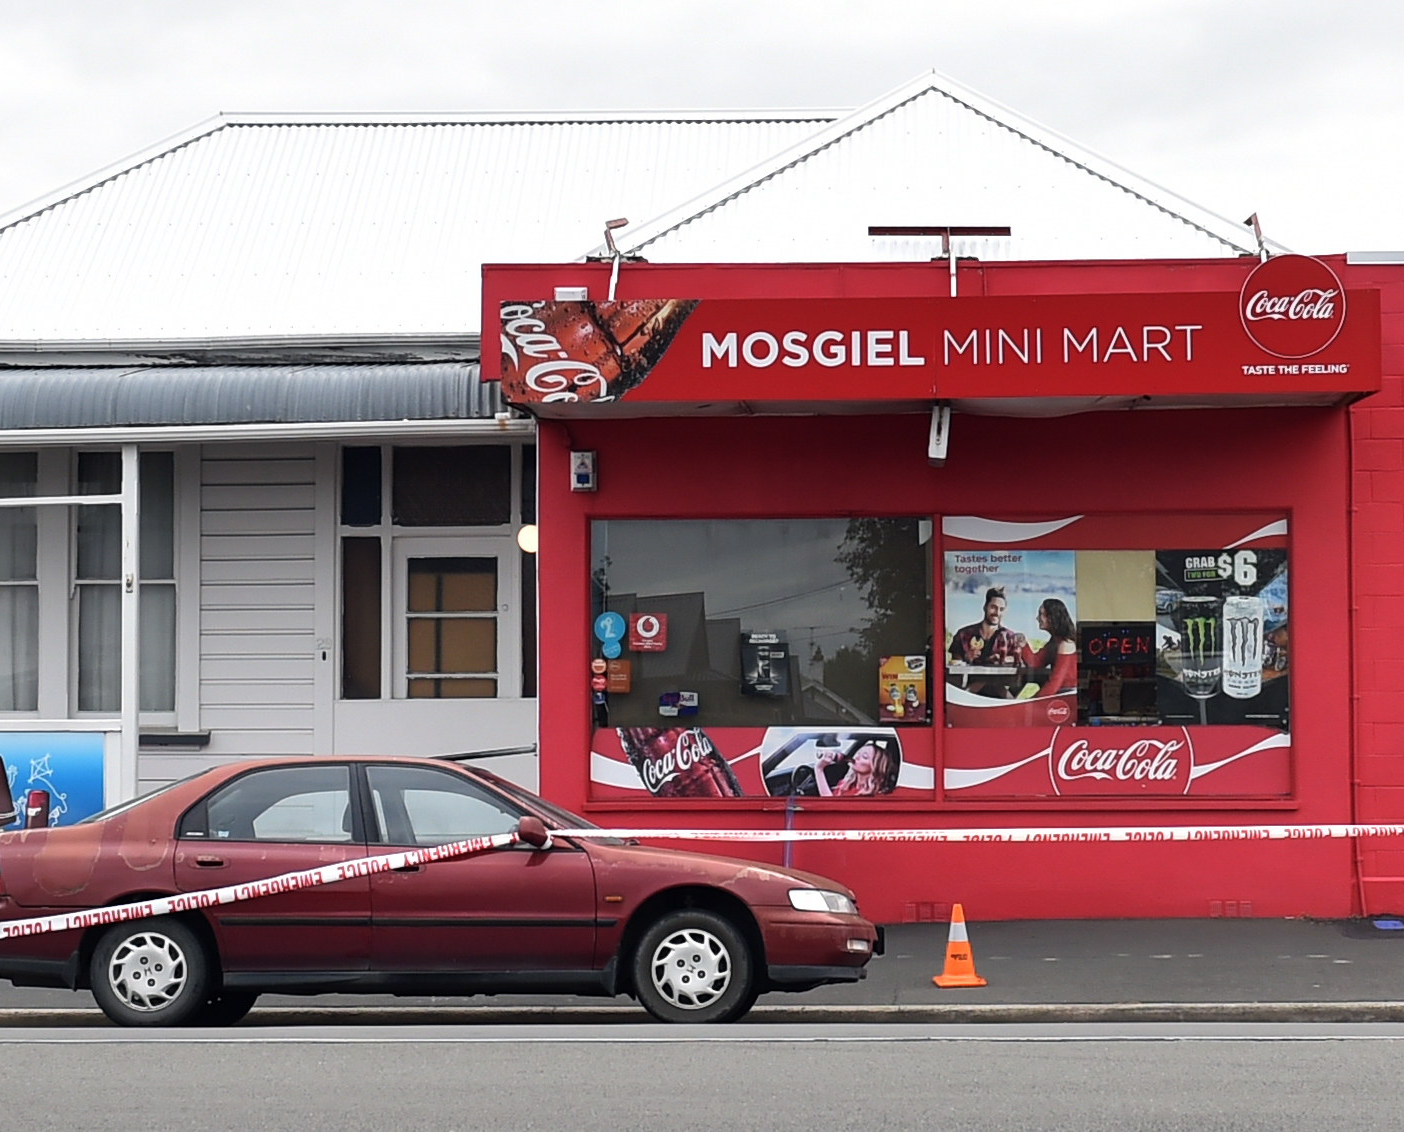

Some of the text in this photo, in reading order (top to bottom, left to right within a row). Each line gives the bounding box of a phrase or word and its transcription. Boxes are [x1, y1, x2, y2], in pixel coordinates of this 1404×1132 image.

[1245, 288, 1339, 321] Coca-Cola
[702, 325, 1203, 368] MOSGIEL MINI MART
[1241, 363, 1348, 375] TASTE THE FEELING
[954, 554, 1022, 563] Tastes better
[1185, 550, 1258, 586] GRAB $6
[954, 565, 999, 574] together
[1187, 571, 1202, 579] TWO
[1089, 636, 1150, 655] OPEN
[1057, 739, 1186, 780] Coca-Cola
[338, 860, 391, 881] POLICE
[233, 871, 323, 899] EMERGENCY
[167, 892, 222, 912] POLICE
[65, 903, 154, 929] EMERGENCY
